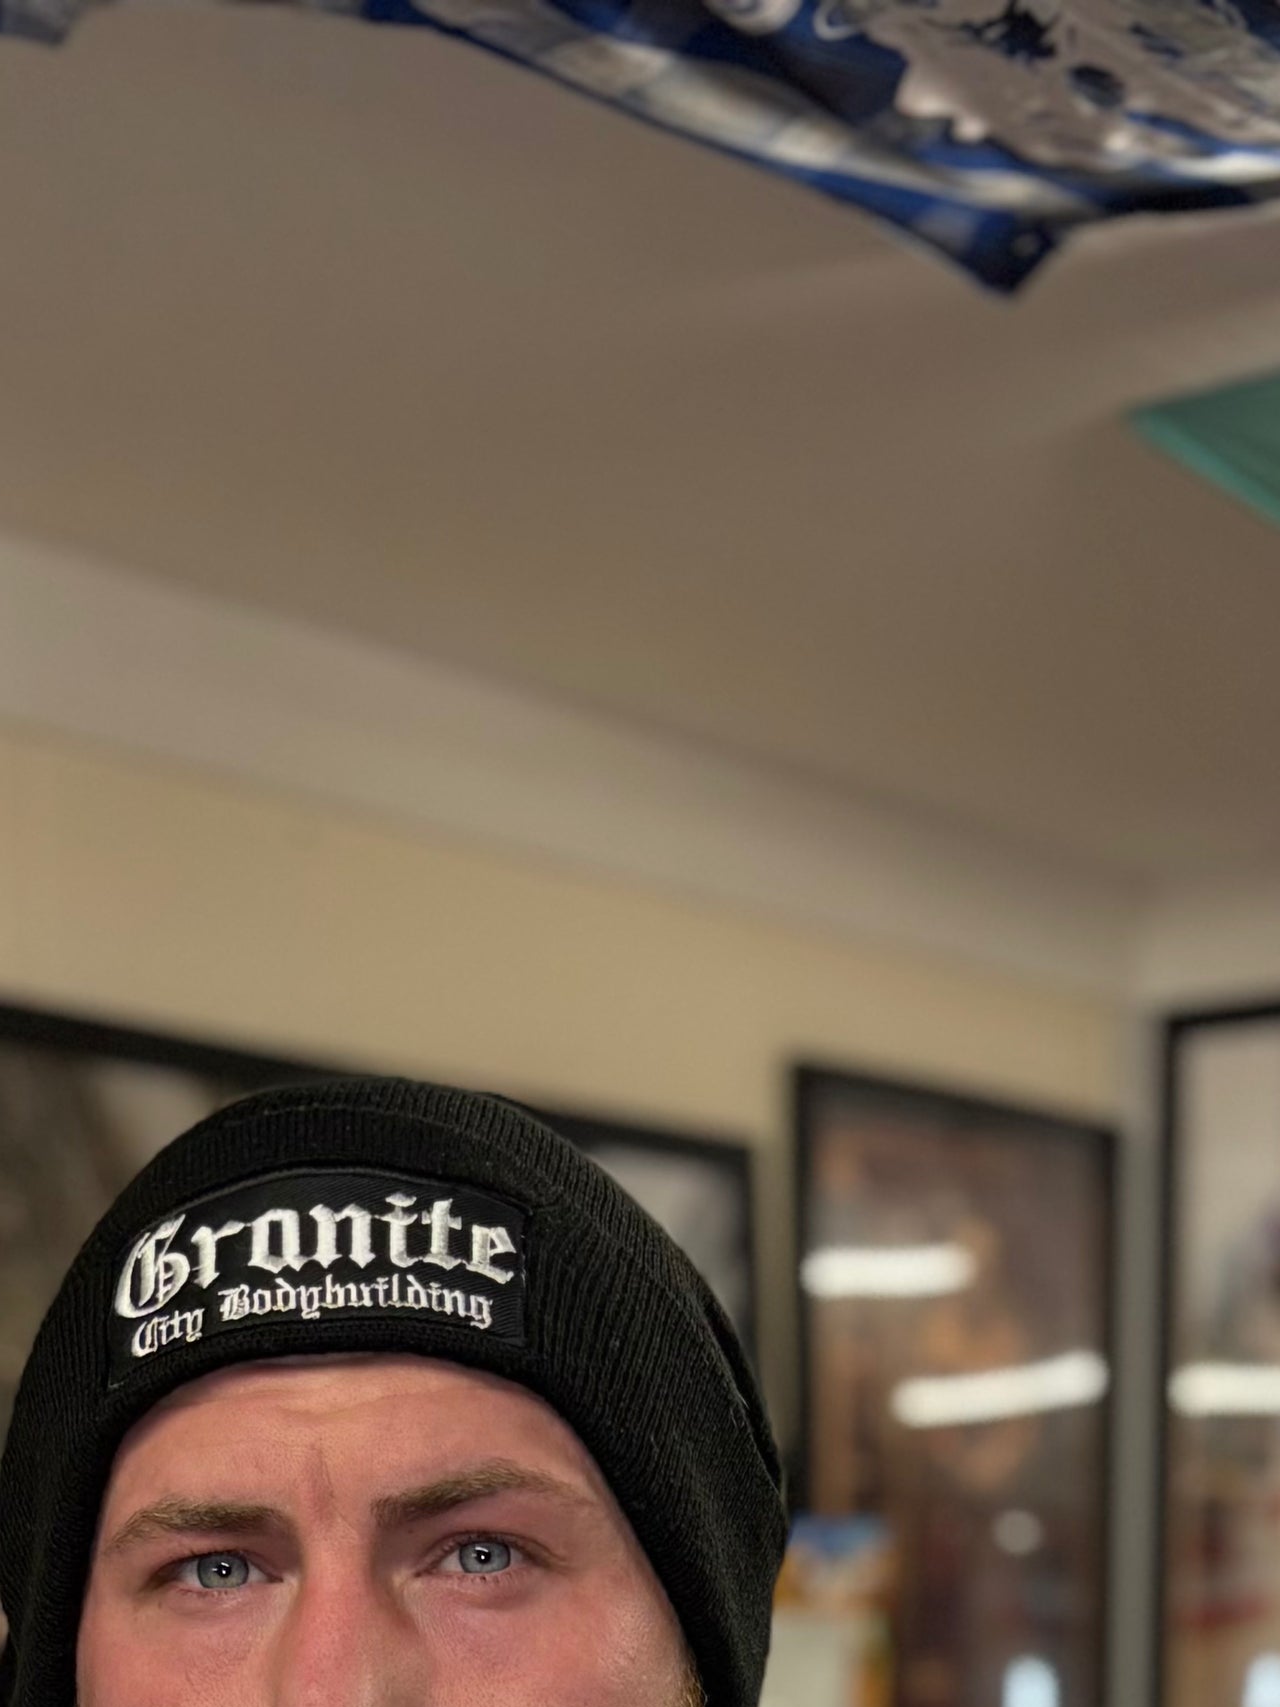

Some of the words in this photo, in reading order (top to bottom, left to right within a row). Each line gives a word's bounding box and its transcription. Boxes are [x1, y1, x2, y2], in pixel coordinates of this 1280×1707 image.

[114, 1192, 517, 1318] Granite
[130, 1307, 205, 1358] City
[219, 1273, 494, 1330] Bodybuilding
